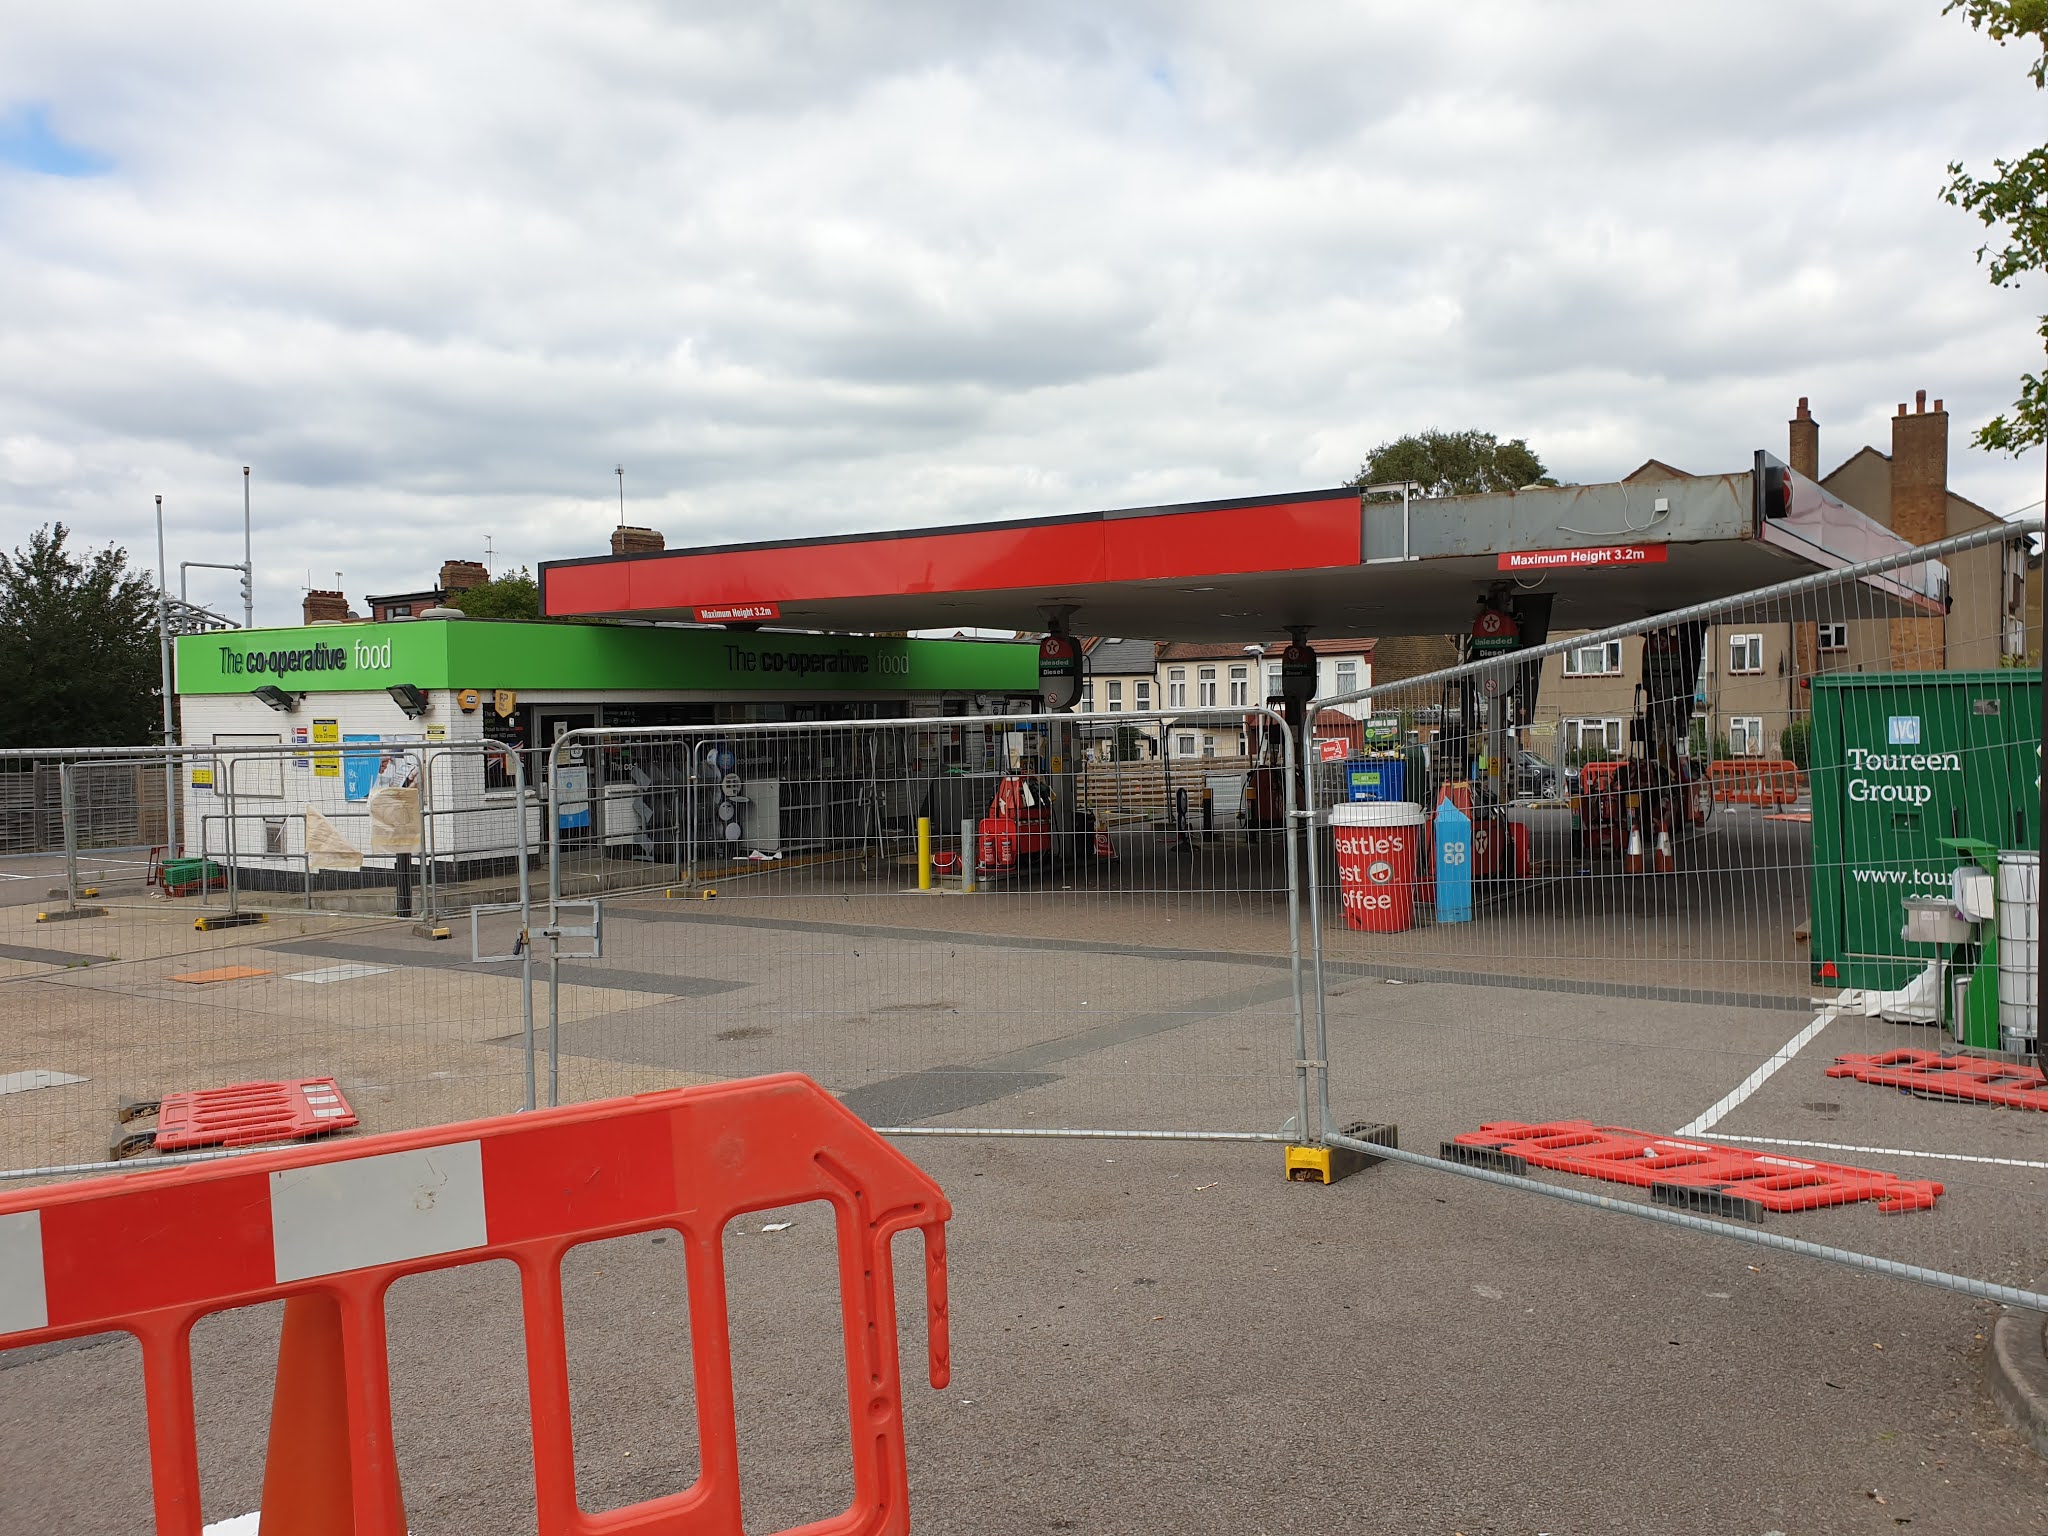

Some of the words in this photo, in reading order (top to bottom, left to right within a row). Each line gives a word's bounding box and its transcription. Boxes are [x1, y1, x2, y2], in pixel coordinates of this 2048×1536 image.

[1510, 554, 1567, 566] Maximum
[1570, 551, 1611, 564] Height
[1614, 549, 1645, 560] 3.2m
[701, 609, 732, 619] Maximum
[732, 608, 754, 619] Height
[754, 607, 772, 616] 3.2m
[1474, 637, 1513, 646] Unleaded
[219, 646, 243, 674] The
[246, 642, 347, 678] co-operative
[354, 637, 392, 670] food
[725, 645, 757, 672] The
[760, 649, 869, 677] co-operative
[877, 650, 910, 674] food
[1479, 649, 1506, 657] Diesel
[1893, 720, 1917, 740] WC
[1847, 748, 1961, 771] Toureen
[1847, 779, 1932, 806] Group
[1335, 835, 1404, 855] eattle's
[1339, 864, 1362, 883] est
[1852, 868, 1953, 886] www.tour
[1342, 889, 1392, 910] offee
